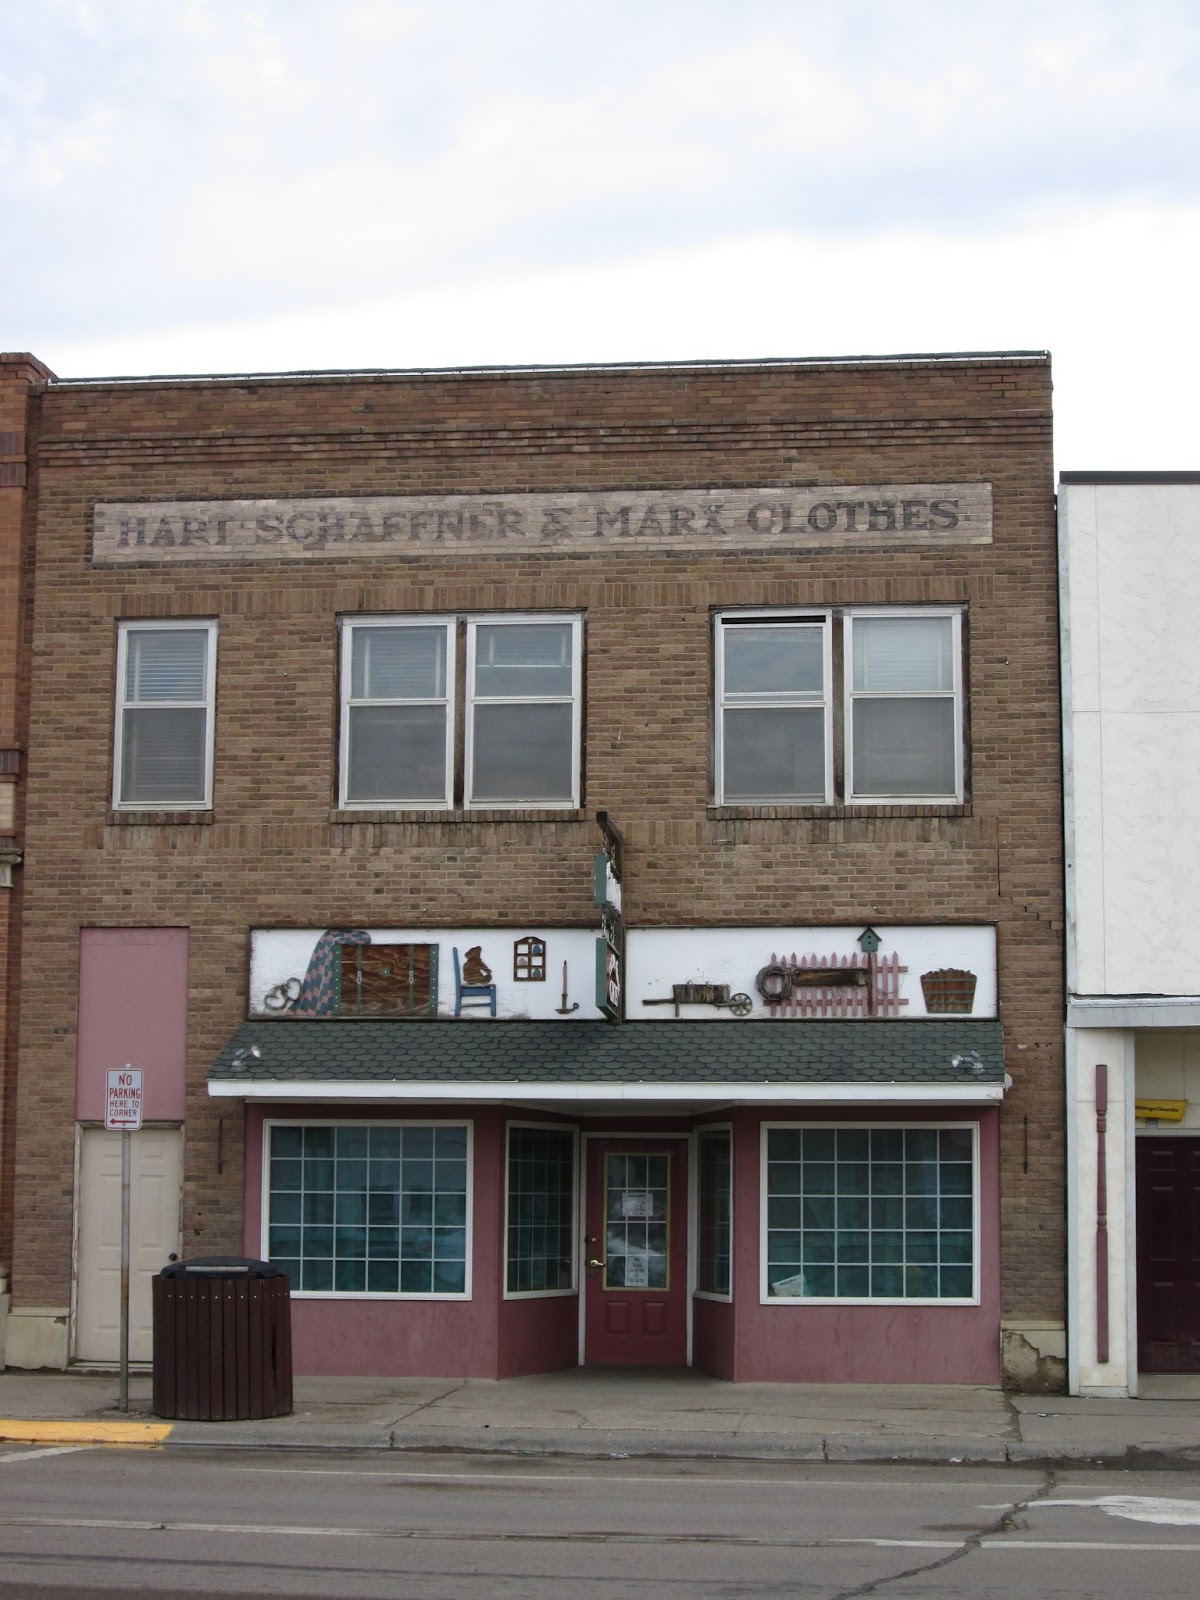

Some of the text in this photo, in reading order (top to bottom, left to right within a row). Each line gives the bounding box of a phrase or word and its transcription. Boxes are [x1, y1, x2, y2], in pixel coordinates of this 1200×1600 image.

[116, 499, 961, 548] HART SCHAFFNER & MARX CLOTHES
[118, 1074, 132, 1086] NO
[109, 1087, 141, 1100] PARKING
[109, 1100, 140, 1108] HERE TO
[109, 1109, 137, 1117] CORNER
